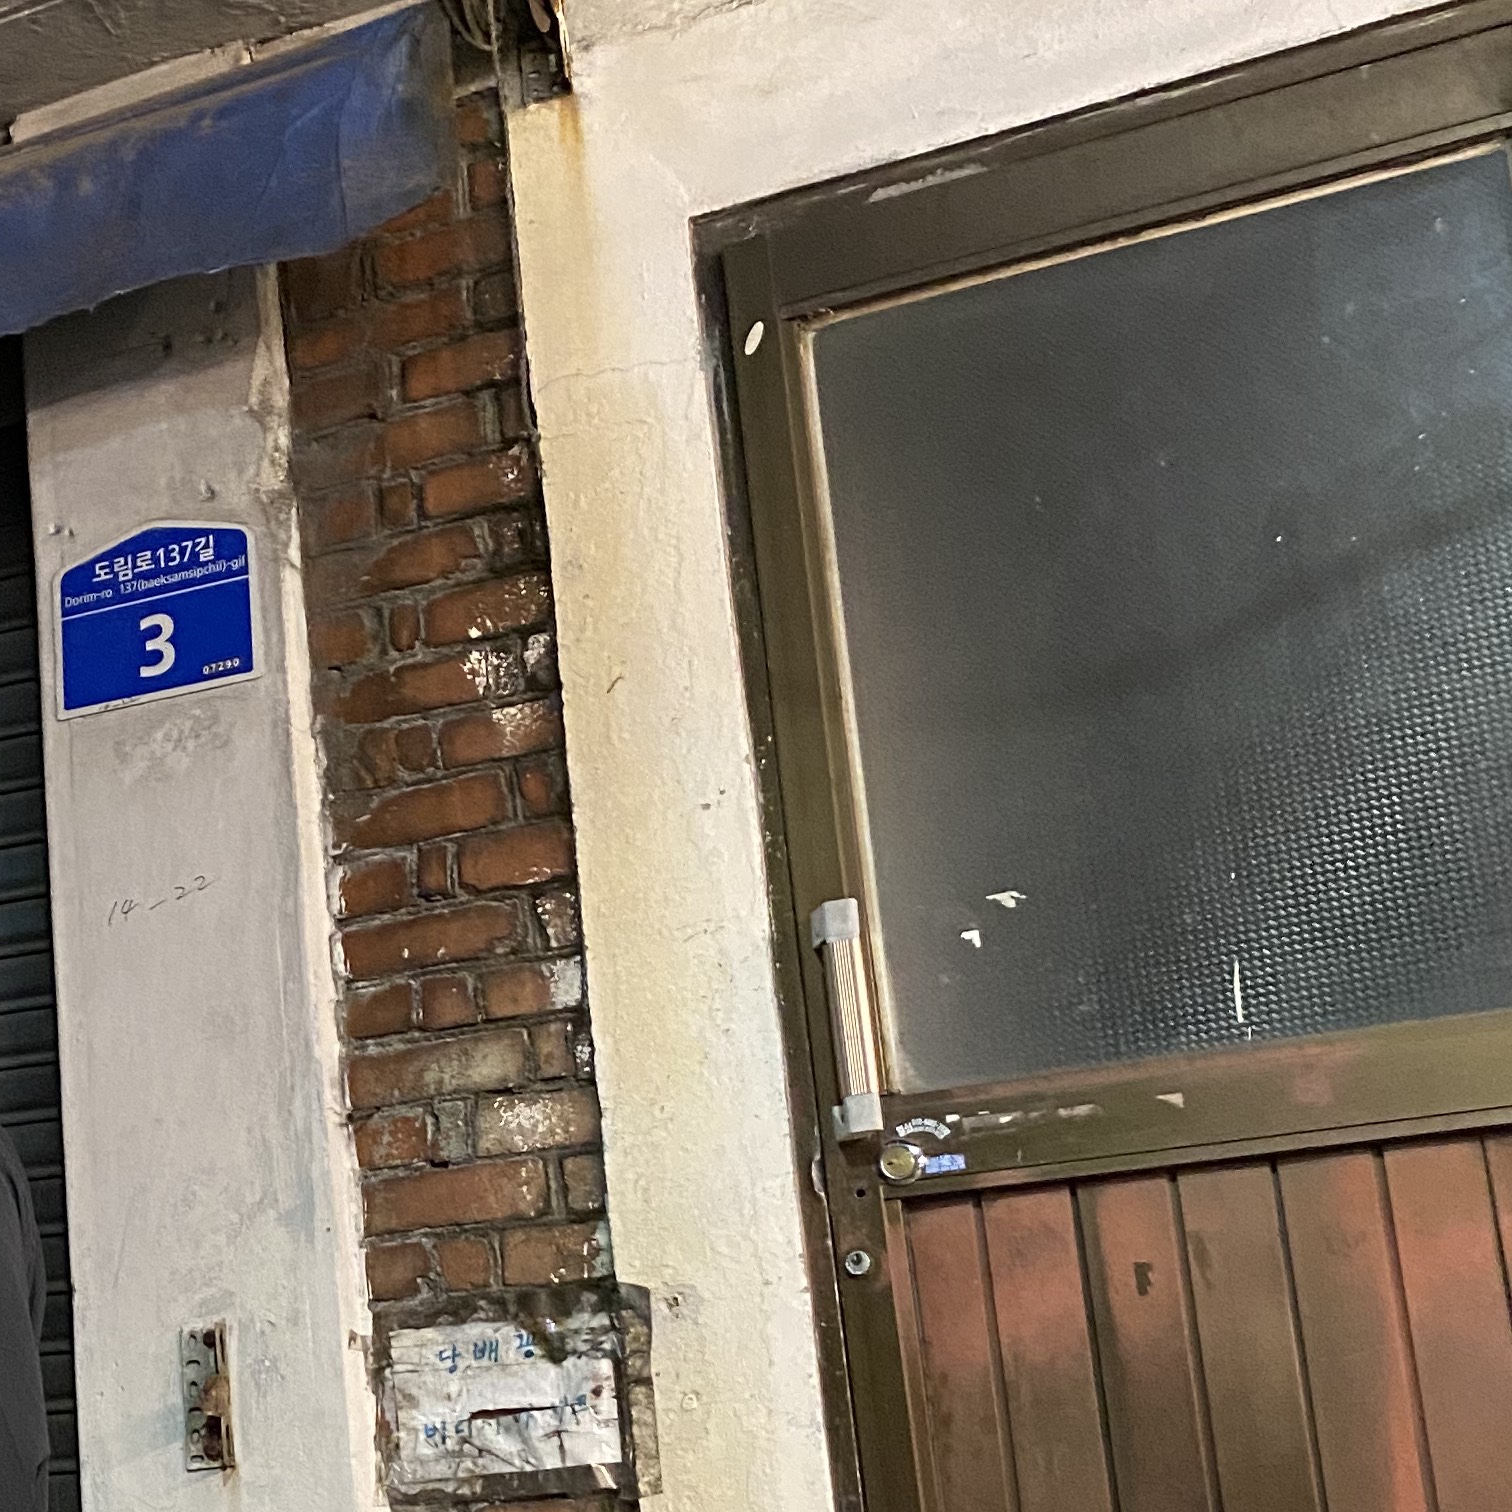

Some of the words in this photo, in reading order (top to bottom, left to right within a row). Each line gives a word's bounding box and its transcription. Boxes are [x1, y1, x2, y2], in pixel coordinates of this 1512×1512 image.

[92, 534, 215, 582] 도림로137길
[64, 588, 113, 608] Dorim-ro
[139, 613, 176, 678] 3
[202, 657, 240, 675] 07290
